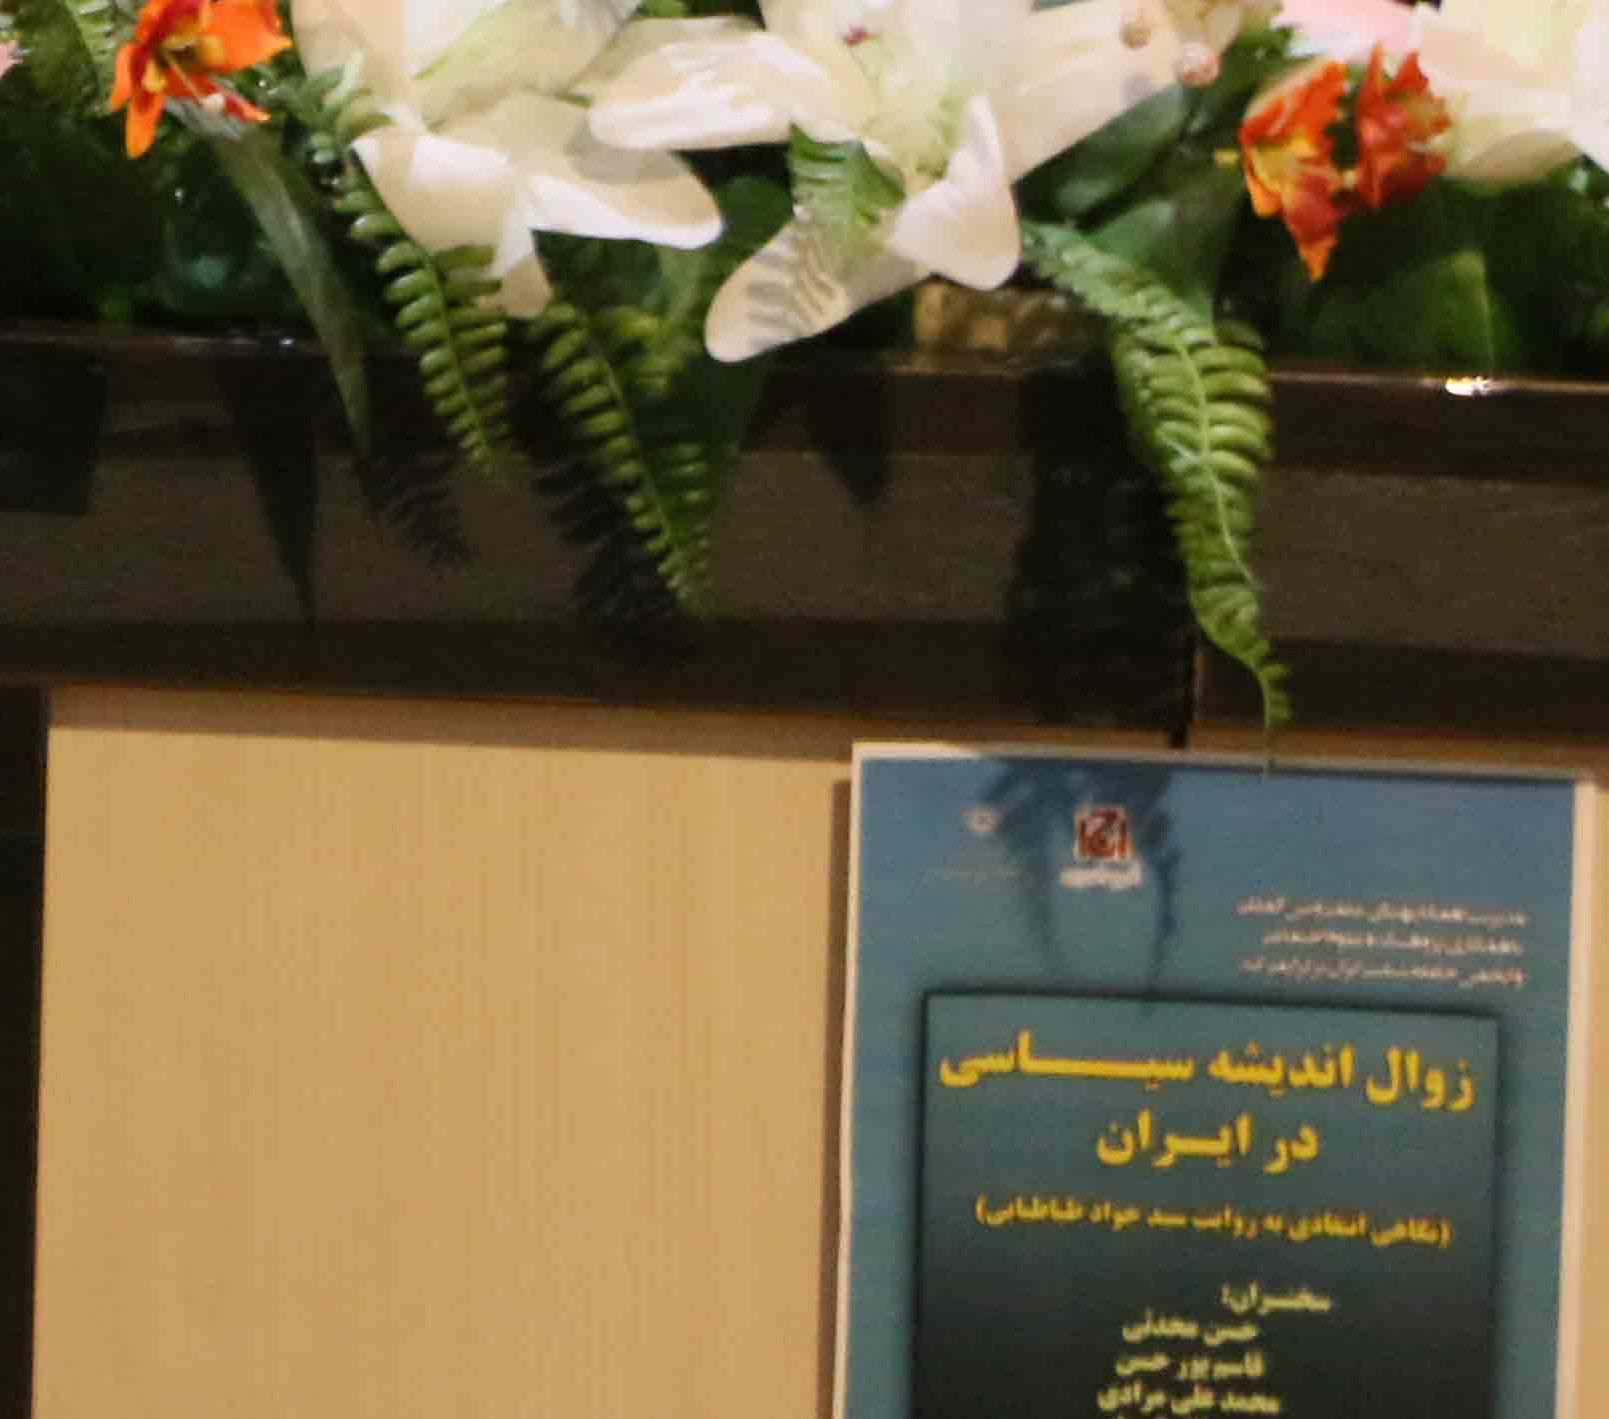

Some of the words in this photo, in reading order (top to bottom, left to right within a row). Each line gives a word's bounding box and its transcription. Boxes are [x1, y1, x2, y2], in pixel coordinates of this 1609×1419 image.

[939, 1028, 1195, 1092] سیاسی
[1207, 1040, 1355, 1096] اندیشه
[1365, 1046, 1474, 1112] زوال
[1094, 1108, 1253, 1168] ایران
[1262, 1123, 1320, 1173] در
[1086, 1200, 1141, 1232] جواد
